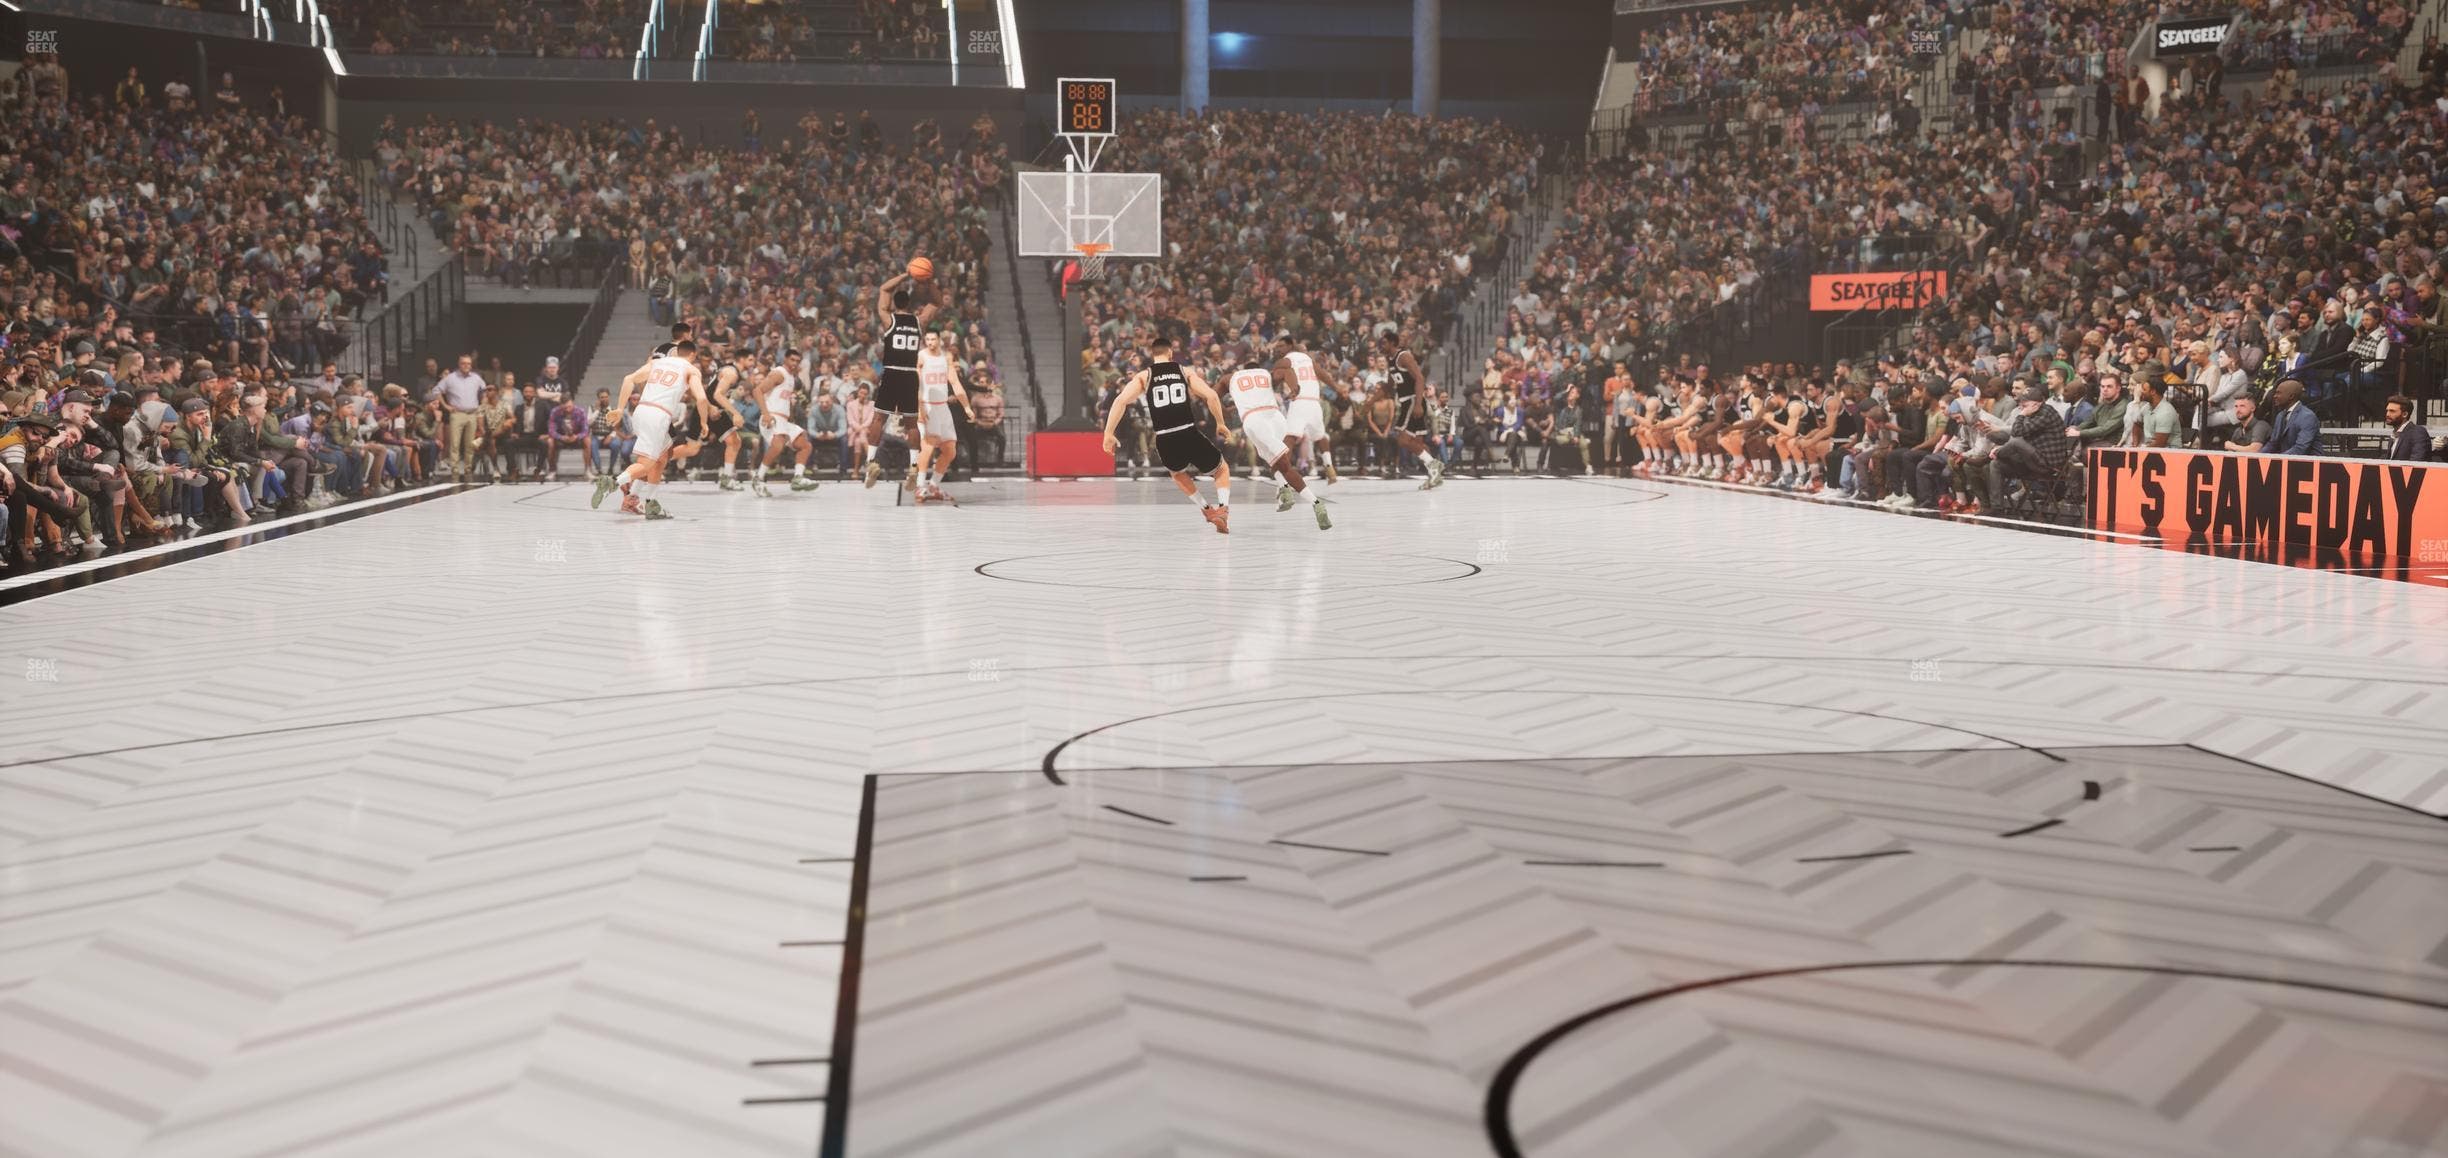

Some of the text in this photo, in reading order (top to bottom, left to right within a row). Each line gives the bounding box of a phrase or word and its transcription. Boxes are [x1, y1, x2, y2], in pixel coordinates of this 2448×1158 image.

[2159, 24, 2228, 48] SEATGEEK
[1073, 103, 1101, 129] 88
[892, 334, 919, 350] 00
[1152, 382, 1187, 408] 00
[1237, 375, 1270, 392] 00
[2087, 450, 2428, 558] IT'S GAMEDAY
